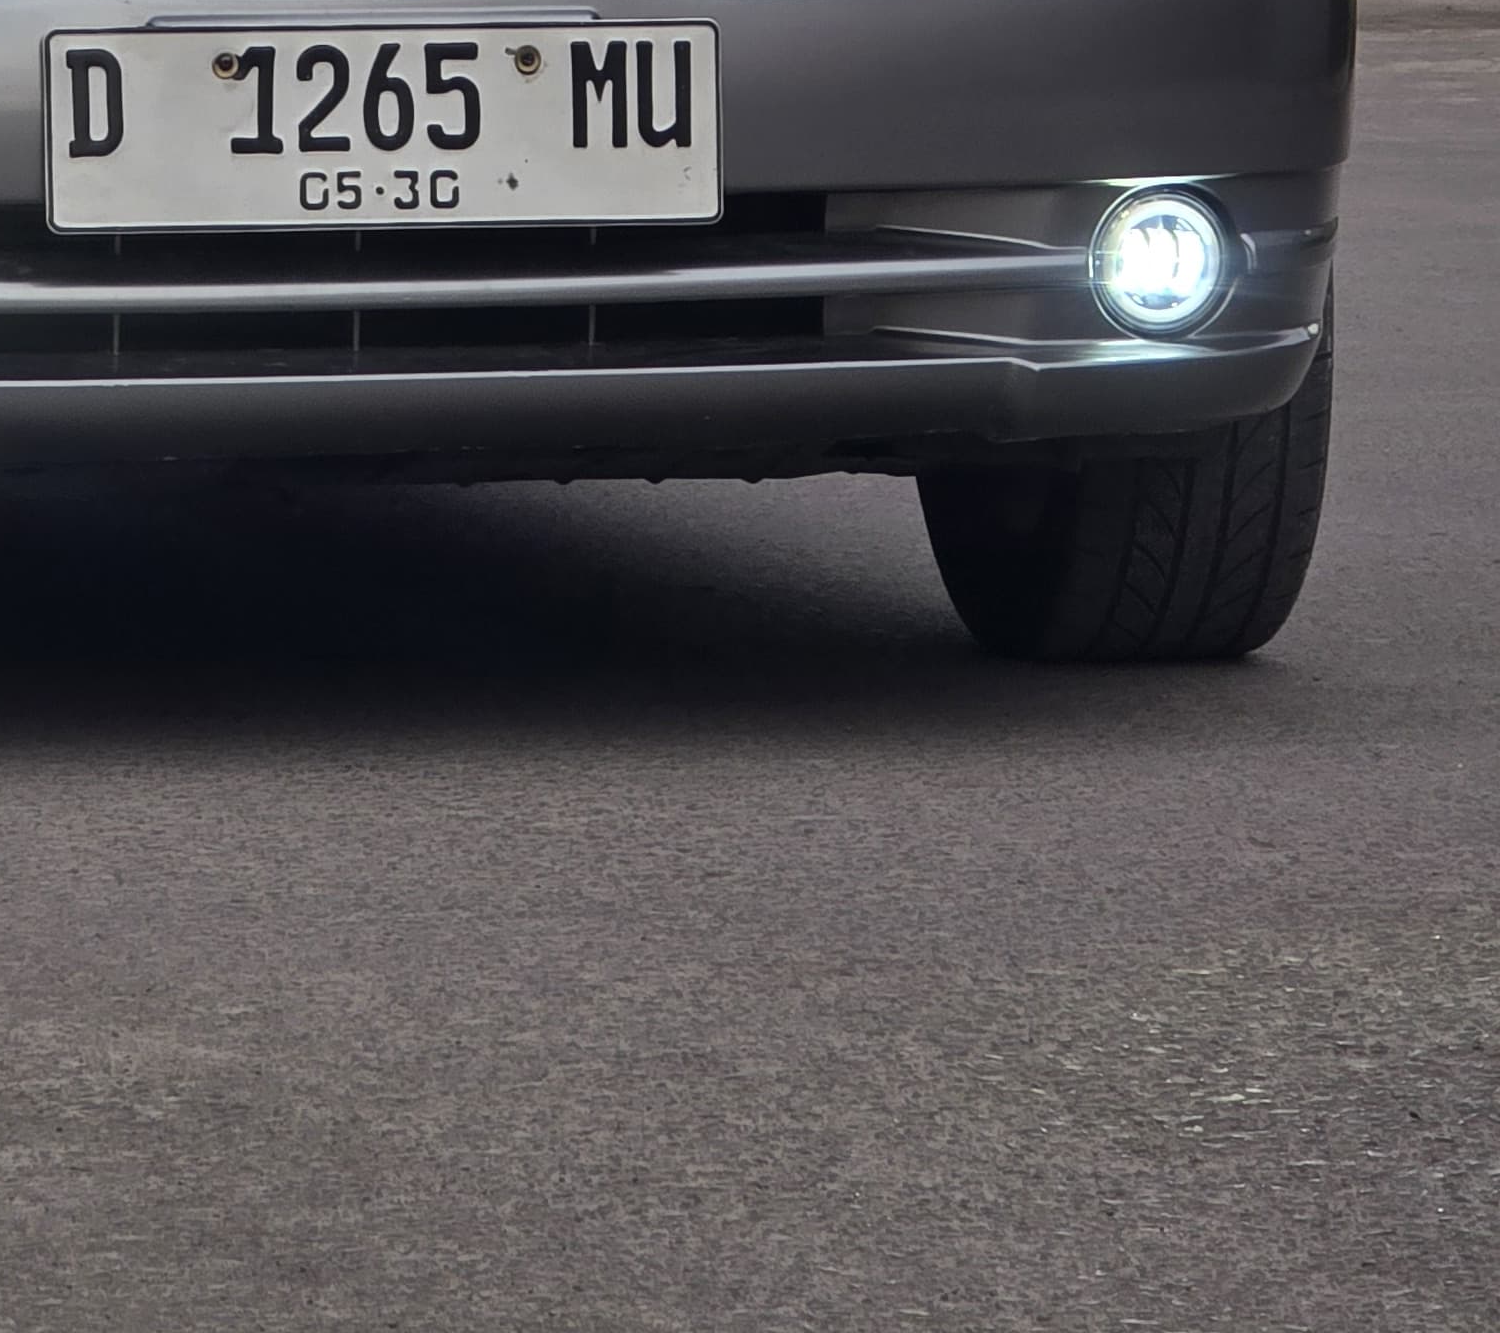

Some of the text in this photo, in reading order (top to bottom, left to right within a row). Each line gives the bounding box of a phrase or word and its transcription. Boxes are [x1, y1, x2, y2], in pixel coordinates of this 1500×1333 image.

[65, 40, 692, 158] D 1265 MU
